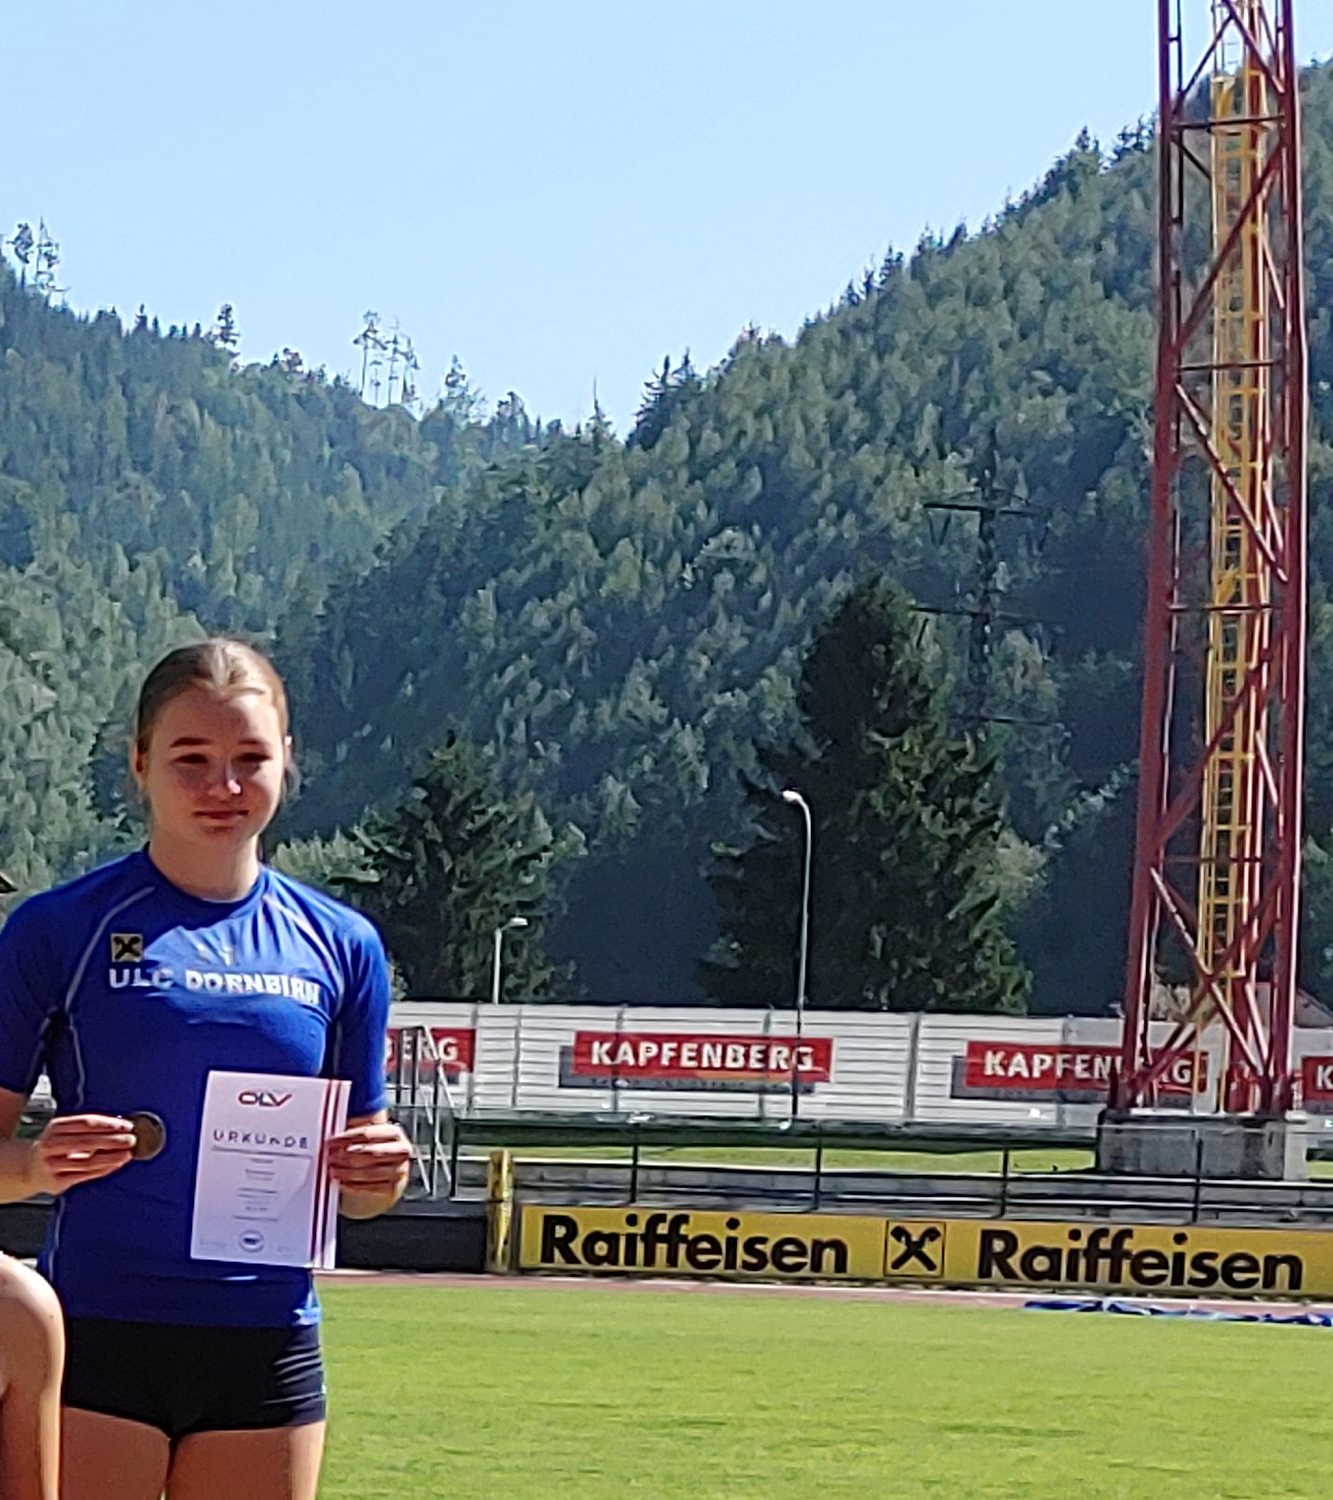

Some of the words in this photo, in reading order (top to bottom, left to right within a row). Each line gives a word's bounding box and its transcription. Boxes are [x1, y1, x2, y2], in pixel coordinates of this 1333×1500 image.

[109, 967, 174, 990] ULC
[185, 969, 321, 1005] DORNBIRN
[590, 1040, 815, 1072] KAPFENBERG
[213, 1128, 308, 1150] URKUNDE
[540, 1213, 849, 1275] Raiffeisen
[978, 1227, 1303, 1291] Raiffeisen
